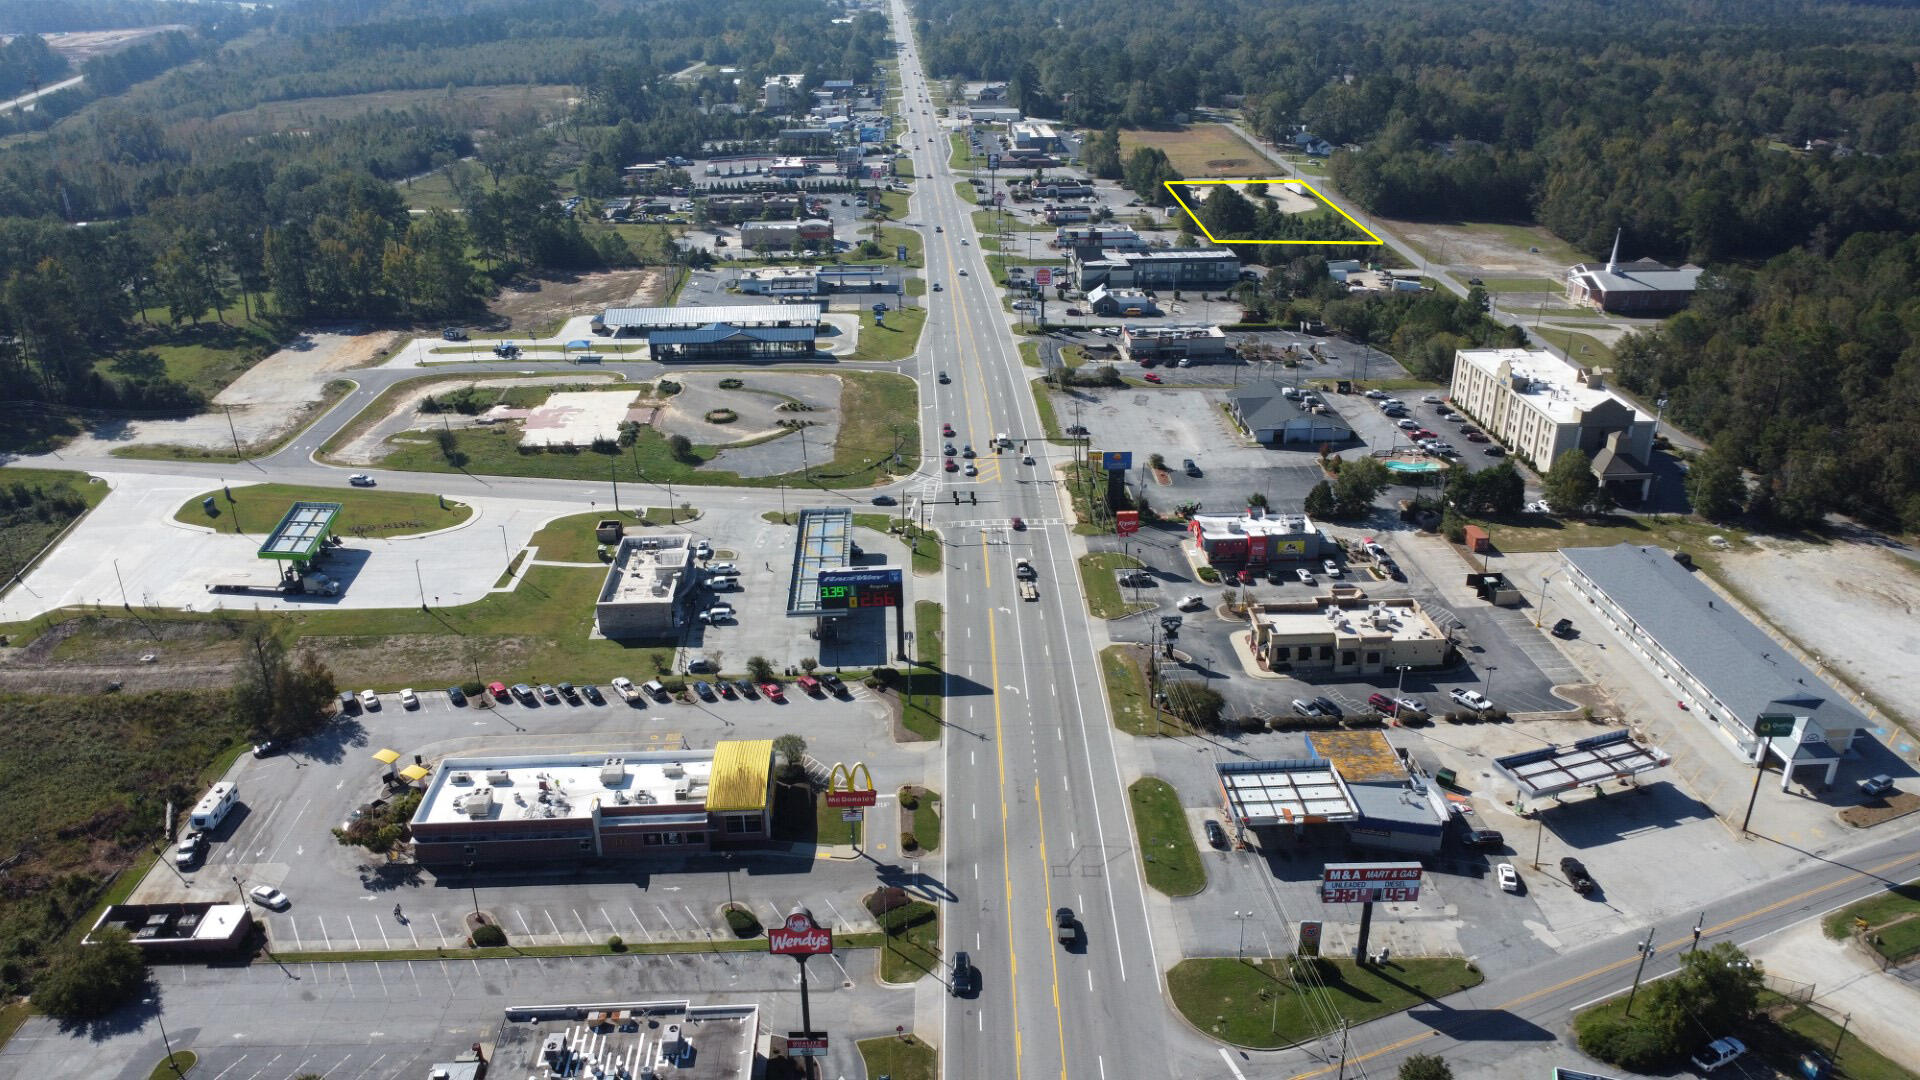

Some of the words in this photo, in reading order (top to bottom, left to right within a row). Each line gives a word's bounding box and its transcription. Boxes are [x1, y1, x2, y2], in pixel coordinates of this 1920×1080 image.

[1365, 870, 1389, 878] MART
[1400, 870, 1418, 878] GAS
[1331, 881, 1367, 889] UNLEADED
[771, 931, 829, 951] Wendy's
